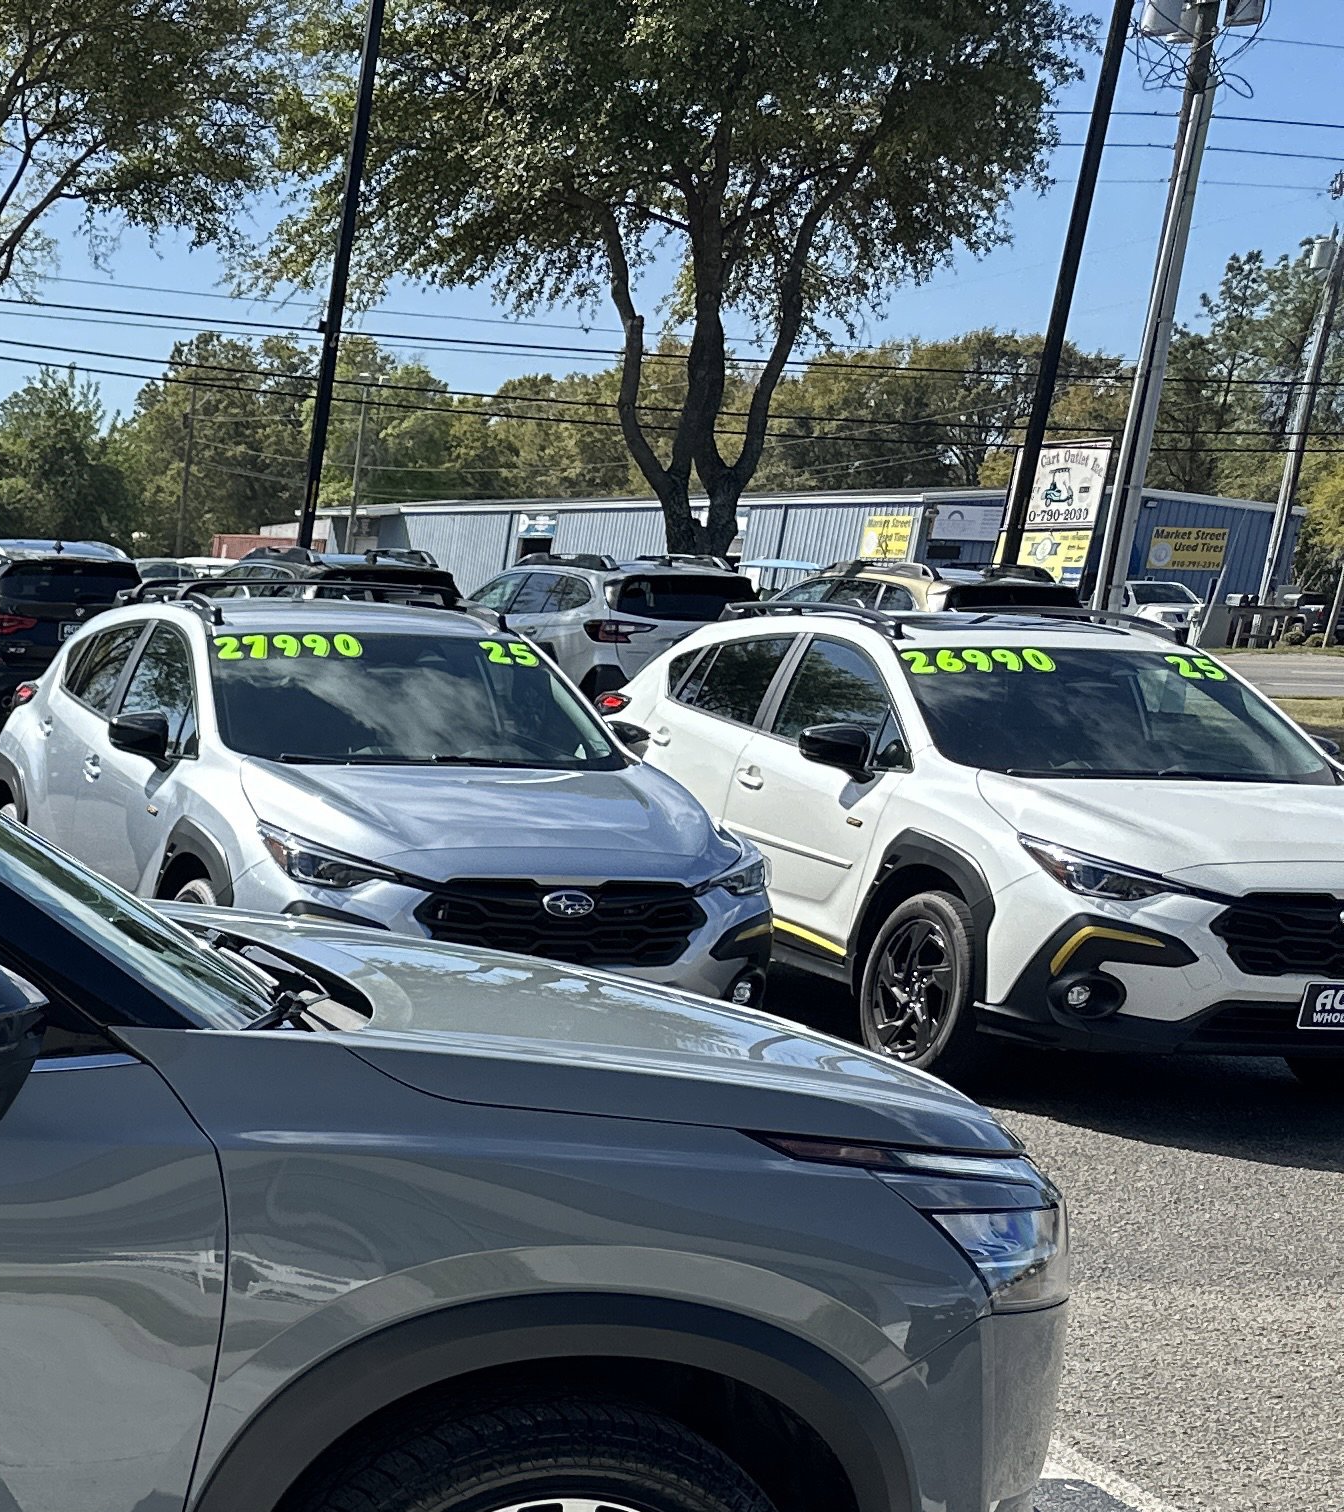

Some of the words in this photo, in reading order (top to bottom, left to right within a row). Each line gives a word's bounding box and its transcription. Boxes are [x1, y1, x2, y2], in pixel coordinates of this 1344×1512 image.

[1041, 451, 1060, 468] Cart
[1064, 450, 1089, 467] Outlet
[1028, 508, 1089, 522] 0-790-2030
[1154, 529, 1192, 539] Market
[1194, 530, 1227, 540] Street
[1174, 542, 1199, 551] Used
[1200, 543, 1224, 552] Tires
[213, 633, 363, 660] 27990
[479, 640, 540, 668] 25
[900, 648, 1057, 674] 26990
[1164, 655, 1228, 681] 25
[1316, 989, 1344, 1011] AU
